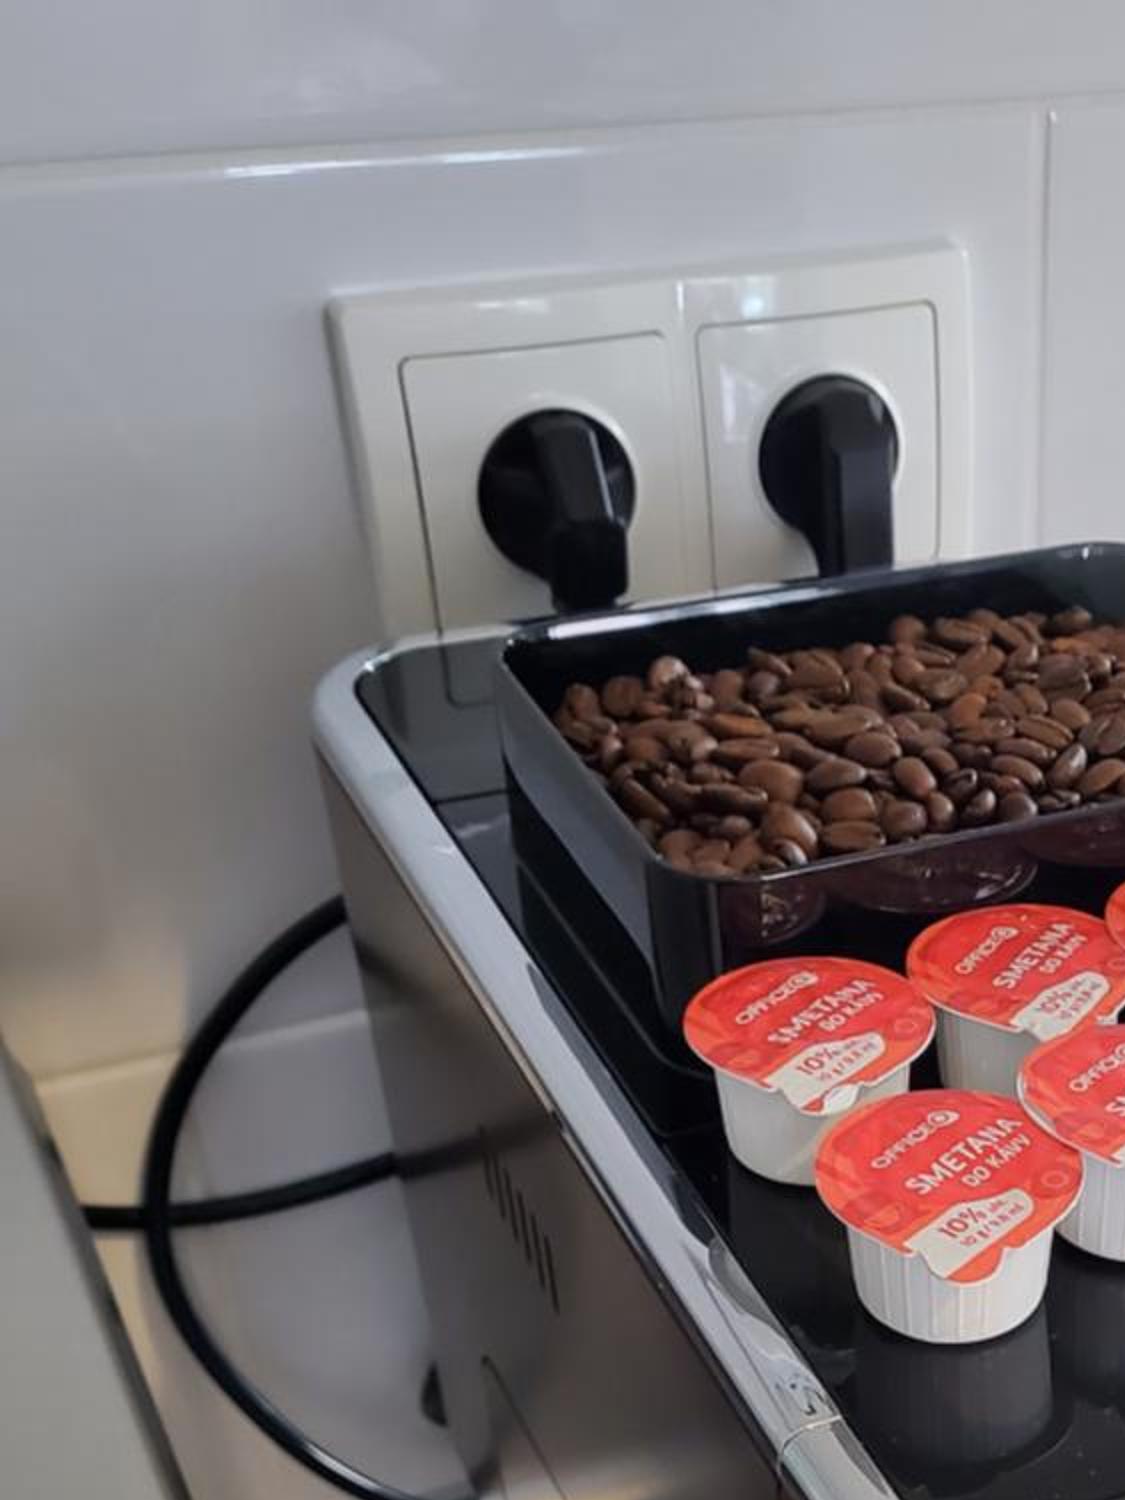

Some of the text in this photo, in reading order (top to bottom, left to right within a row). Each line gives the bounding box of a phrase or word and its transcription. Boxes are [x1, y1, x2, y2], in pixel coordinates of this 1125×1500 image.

[992, 923, 1074, 990] SMETANA
[767, 979, 876, 1043] SMETANA
[796, 1047, 842, 1075] 10%
[905, 1118, 1022, 1195] SMETANA
[961, 1165, 992, 1187] DO
[938, 1207, 988, 1239] 10%
